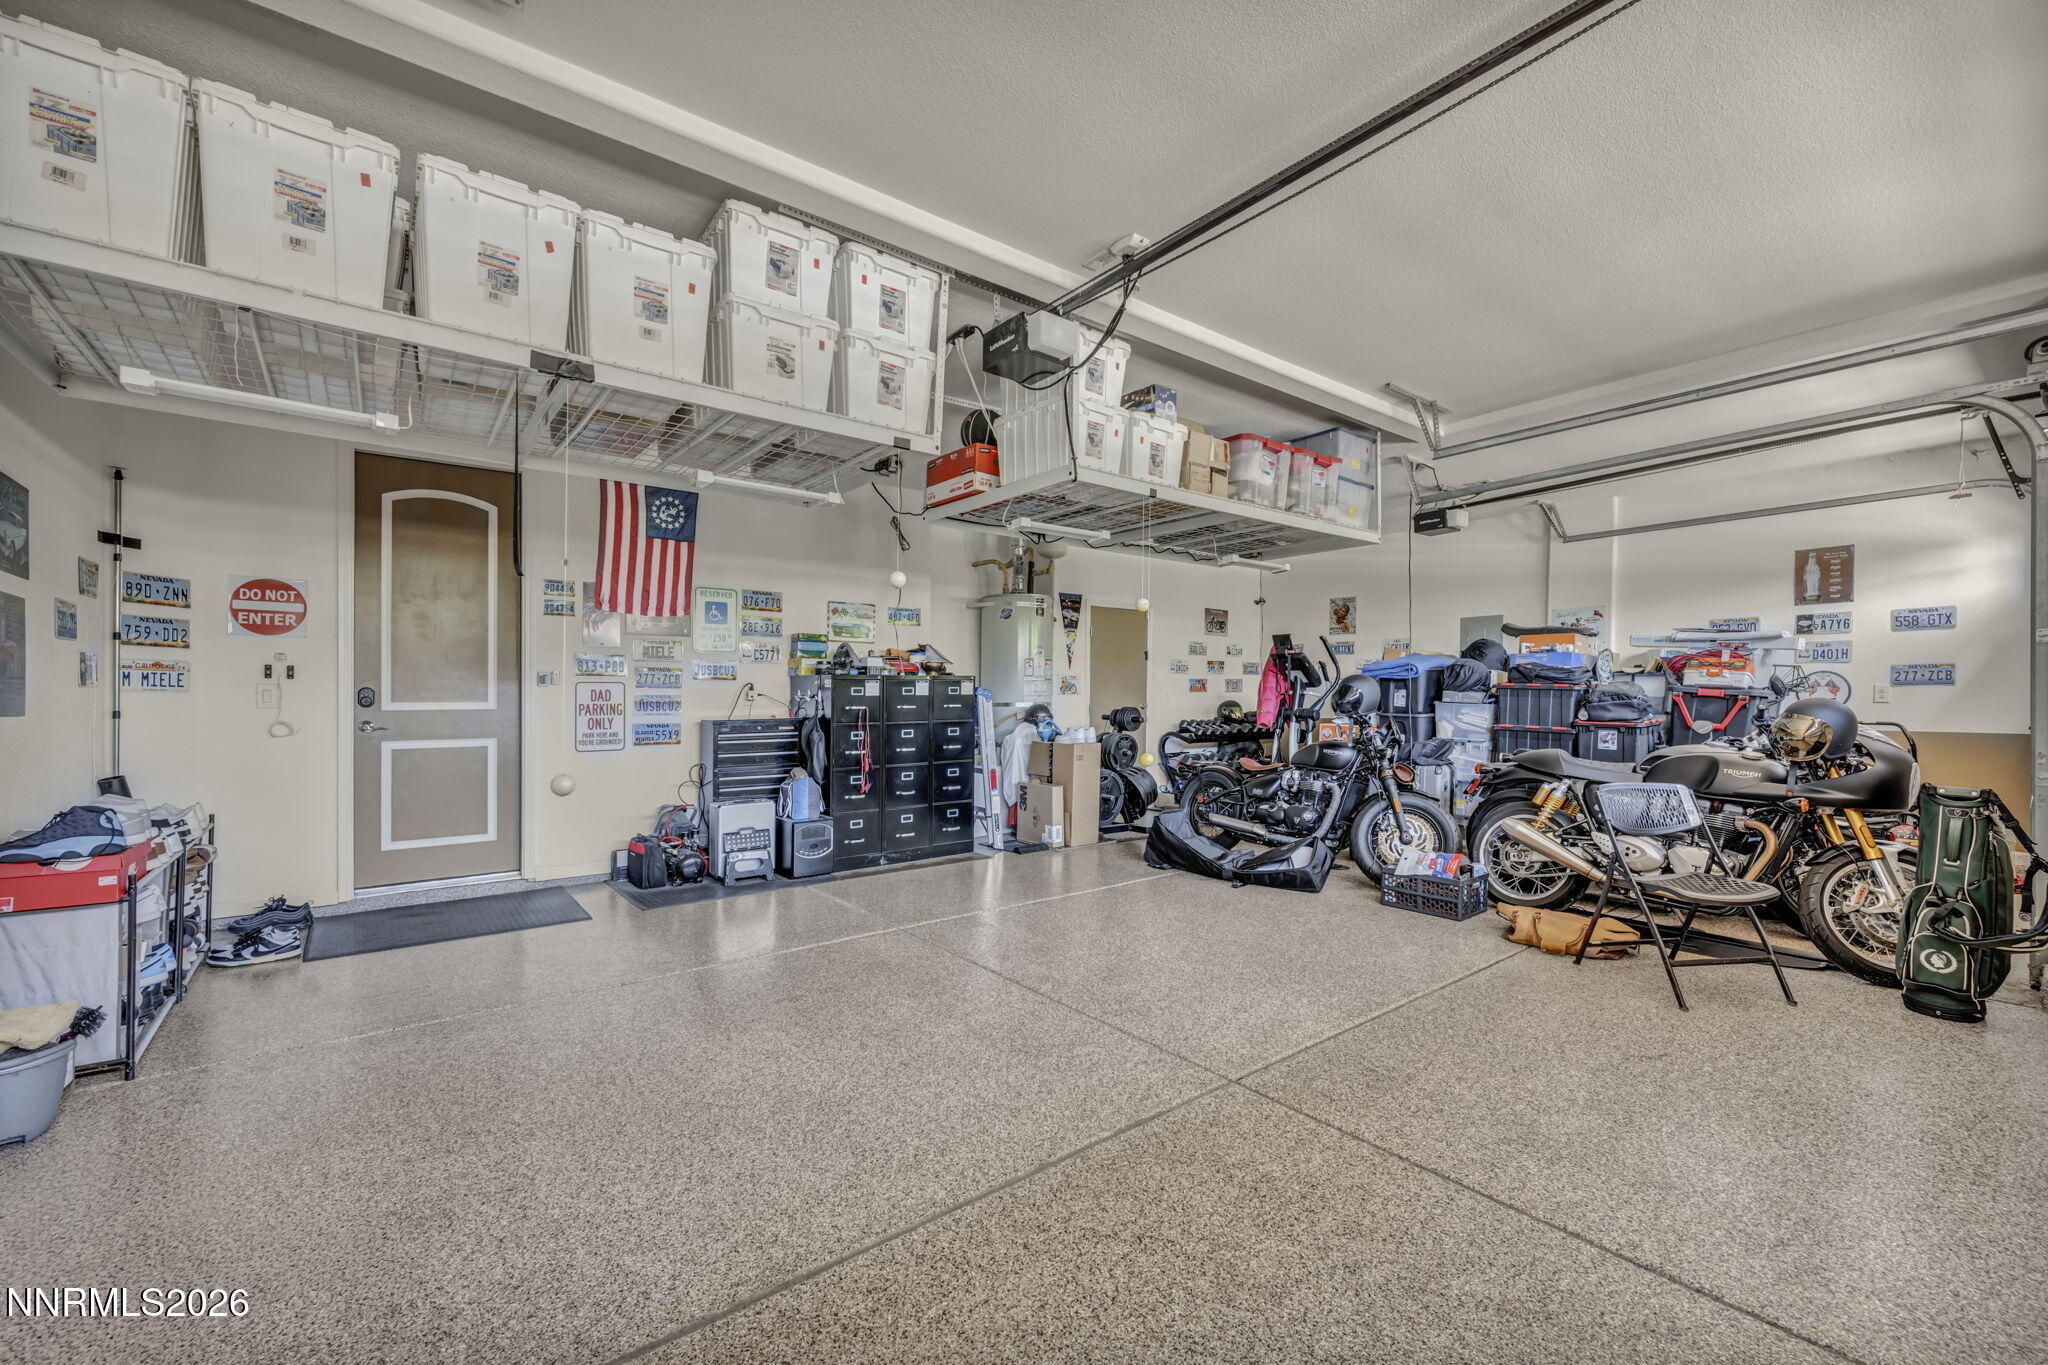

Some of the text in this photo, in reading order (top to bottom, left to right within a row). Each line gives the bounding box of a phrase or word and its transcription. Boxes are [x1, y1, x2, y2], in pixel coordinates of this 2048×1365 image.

[140, 574, 174, 584] NEVADA
[239, 588, 298, 602] DO NOT
[700, 590, 733, 599] RESERVED
[139, 616, 174, 625] NEVADA
[238, 611, 297, 626] ENTER
[642, 646, 675, 658] MIELE
[134, 662, 176, 670] CALIFORNIA
[122, 671, 185, 687] M MIELE
[590, 689, 612, 702] DAD
[578, 703, 623, 716] PARKING
[587, 717, 614, 730] ONLY
[1723, 768, 1762, 778] TRIUMPH
[1020, 785, 1028, 811] 3M
